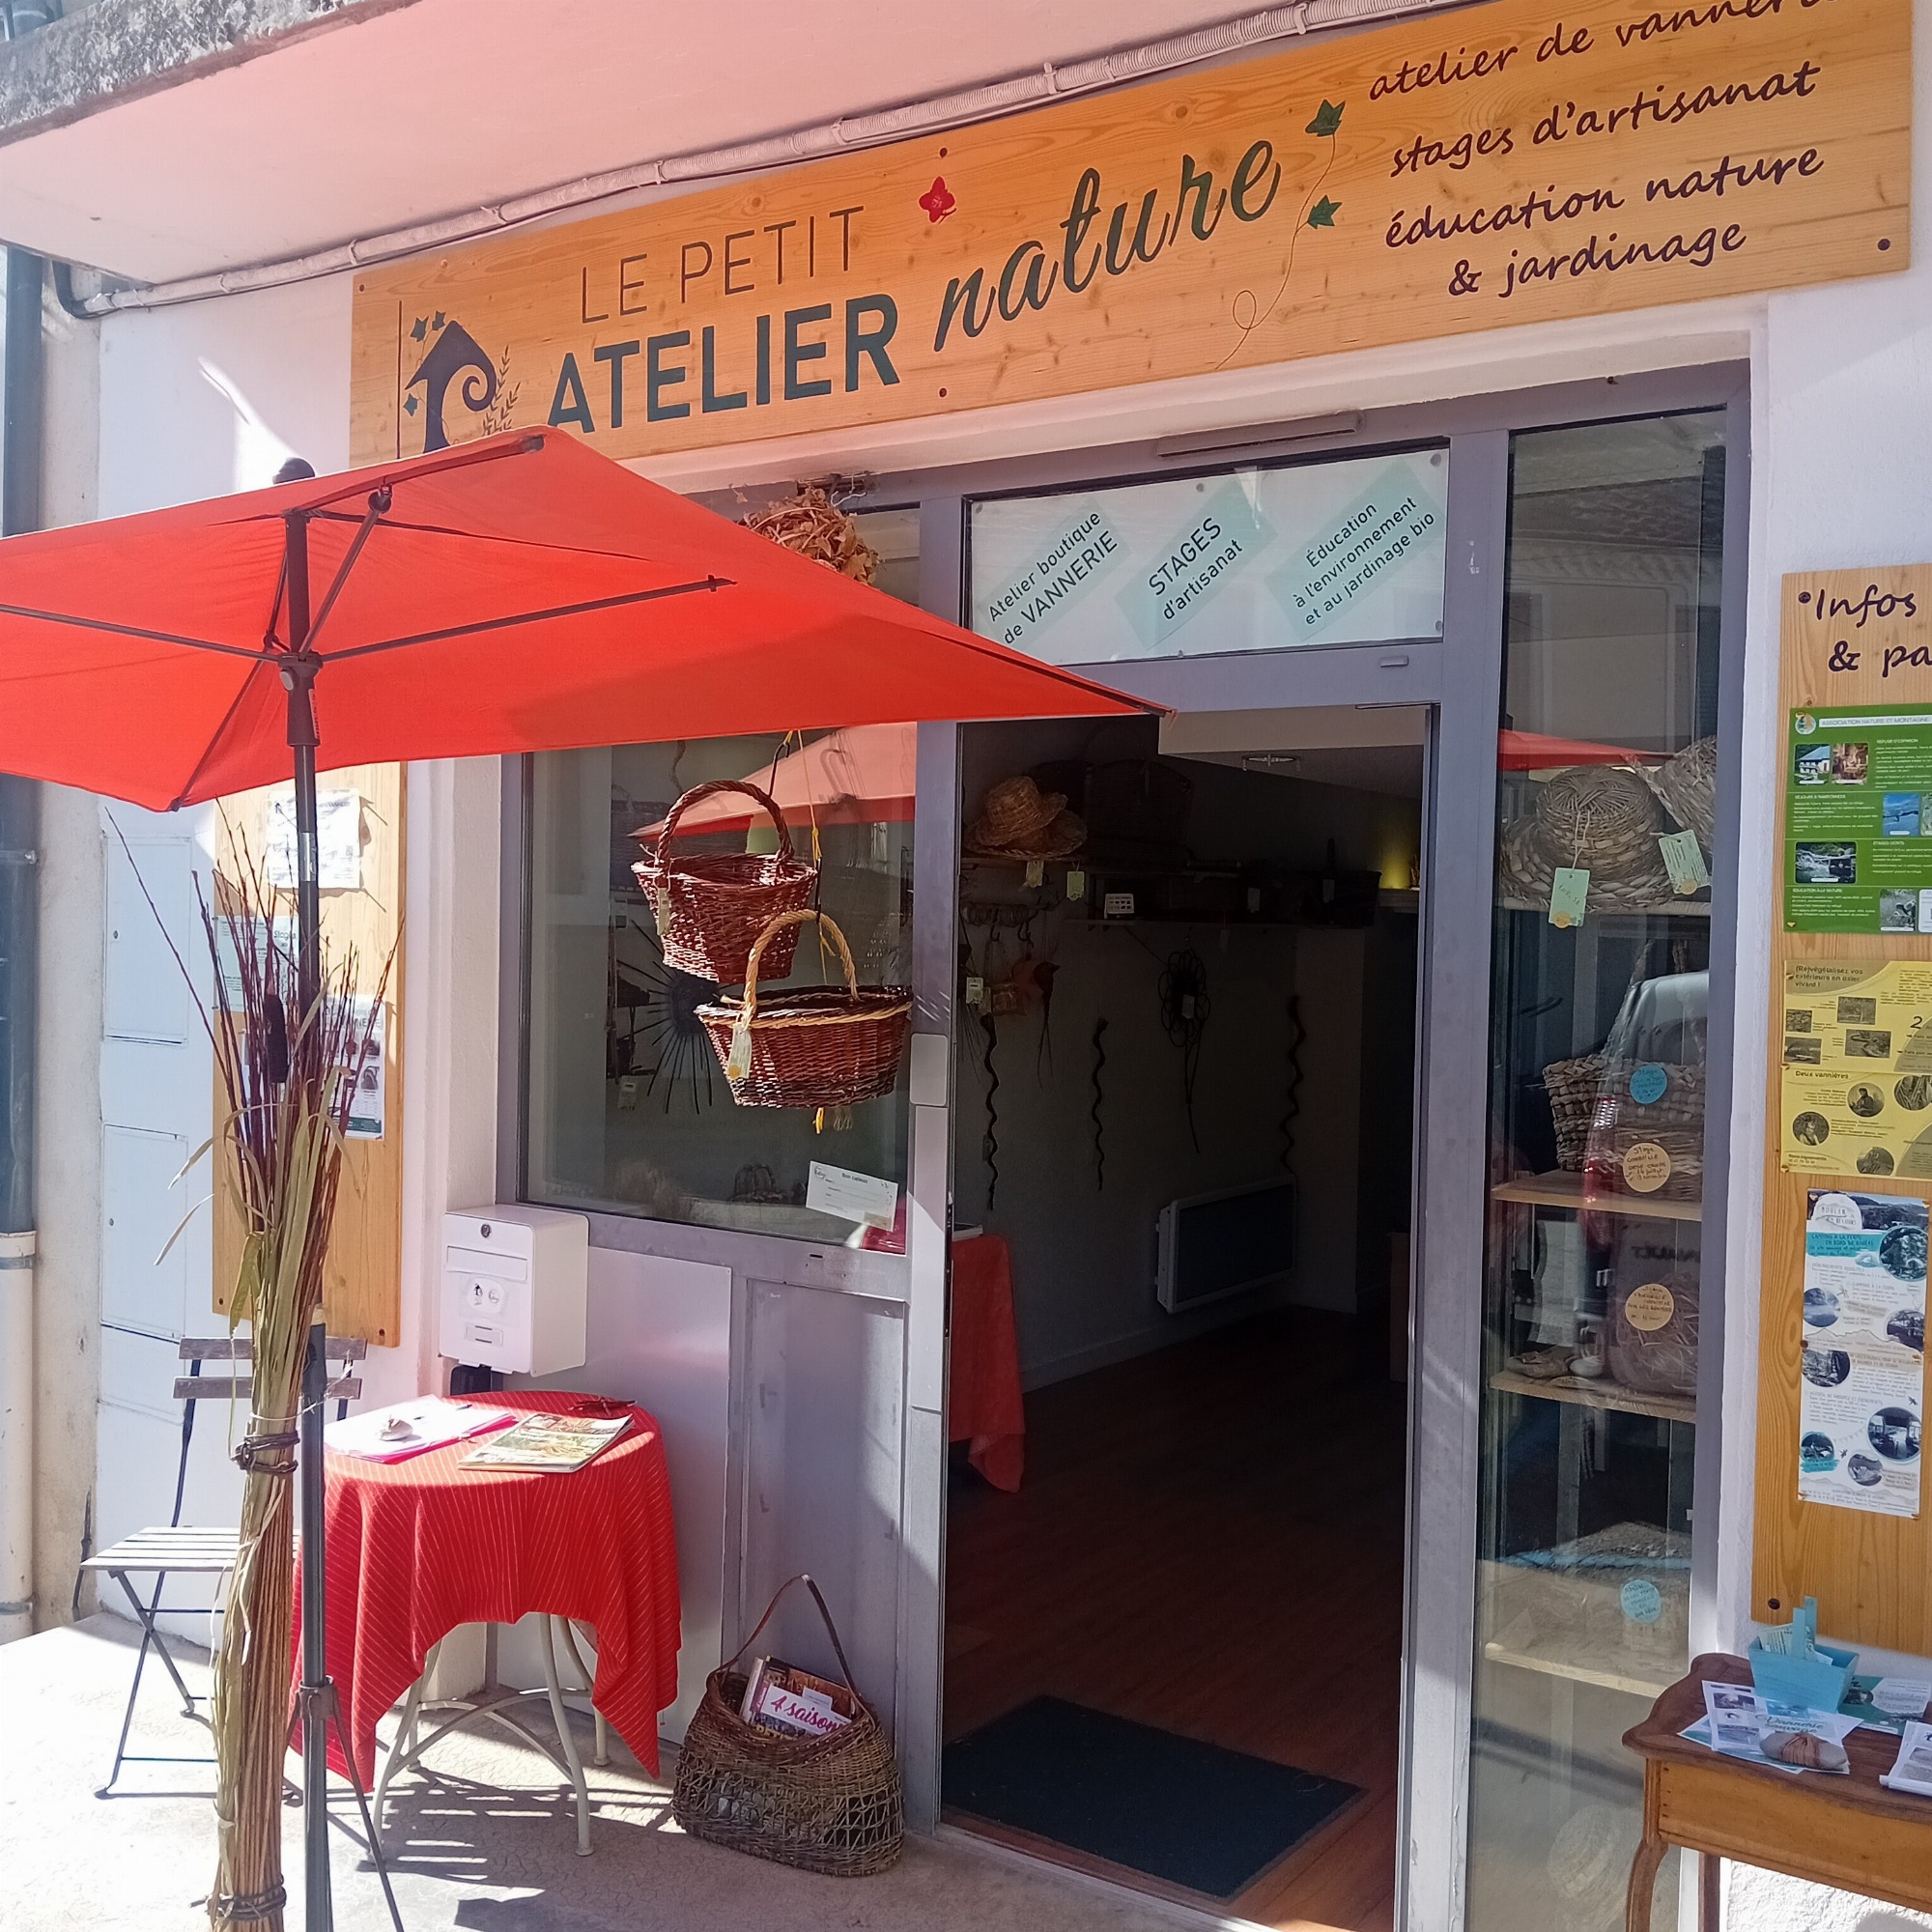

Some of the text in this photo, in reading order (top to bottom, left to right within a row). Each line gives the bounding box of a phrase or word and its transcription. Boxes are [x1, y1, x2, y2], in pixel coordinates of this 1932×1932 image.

[1369, 0, 1833, 100] atelier de vanner
[1389, 61, 1822, 178] stages d'artisanat
[933, 140, 1282, 353] nature
[1385, 148, 1825, 248] éducation nature
[582, 206, 865, 325] LE PETIT
[1447, 223, 1747, 298] & jardinage
[547, 294, 901, 434] ATELIER
[987, 511, 1102, 623] Atelier boutique
[1149, 517, 1223, 596] STAGES
[1162, 538, 1244, 621] d'artisanat
[1294, 497, 1418, 609] à l'environnement
[1304, 502, 1378, 568] Éducation
[1305, 511, 1436, 628] et au jardinage bio
[1004, 530, 1119, 645] de VANNERIE
[1816, 583, 1917, 628] Infos
[1829, 640, 1861, 672] &
[1910, 1015, 1923, 1029] 2
[770, 1695, 788, 1713] 4
[783, 1702, 845, 1733] saison
